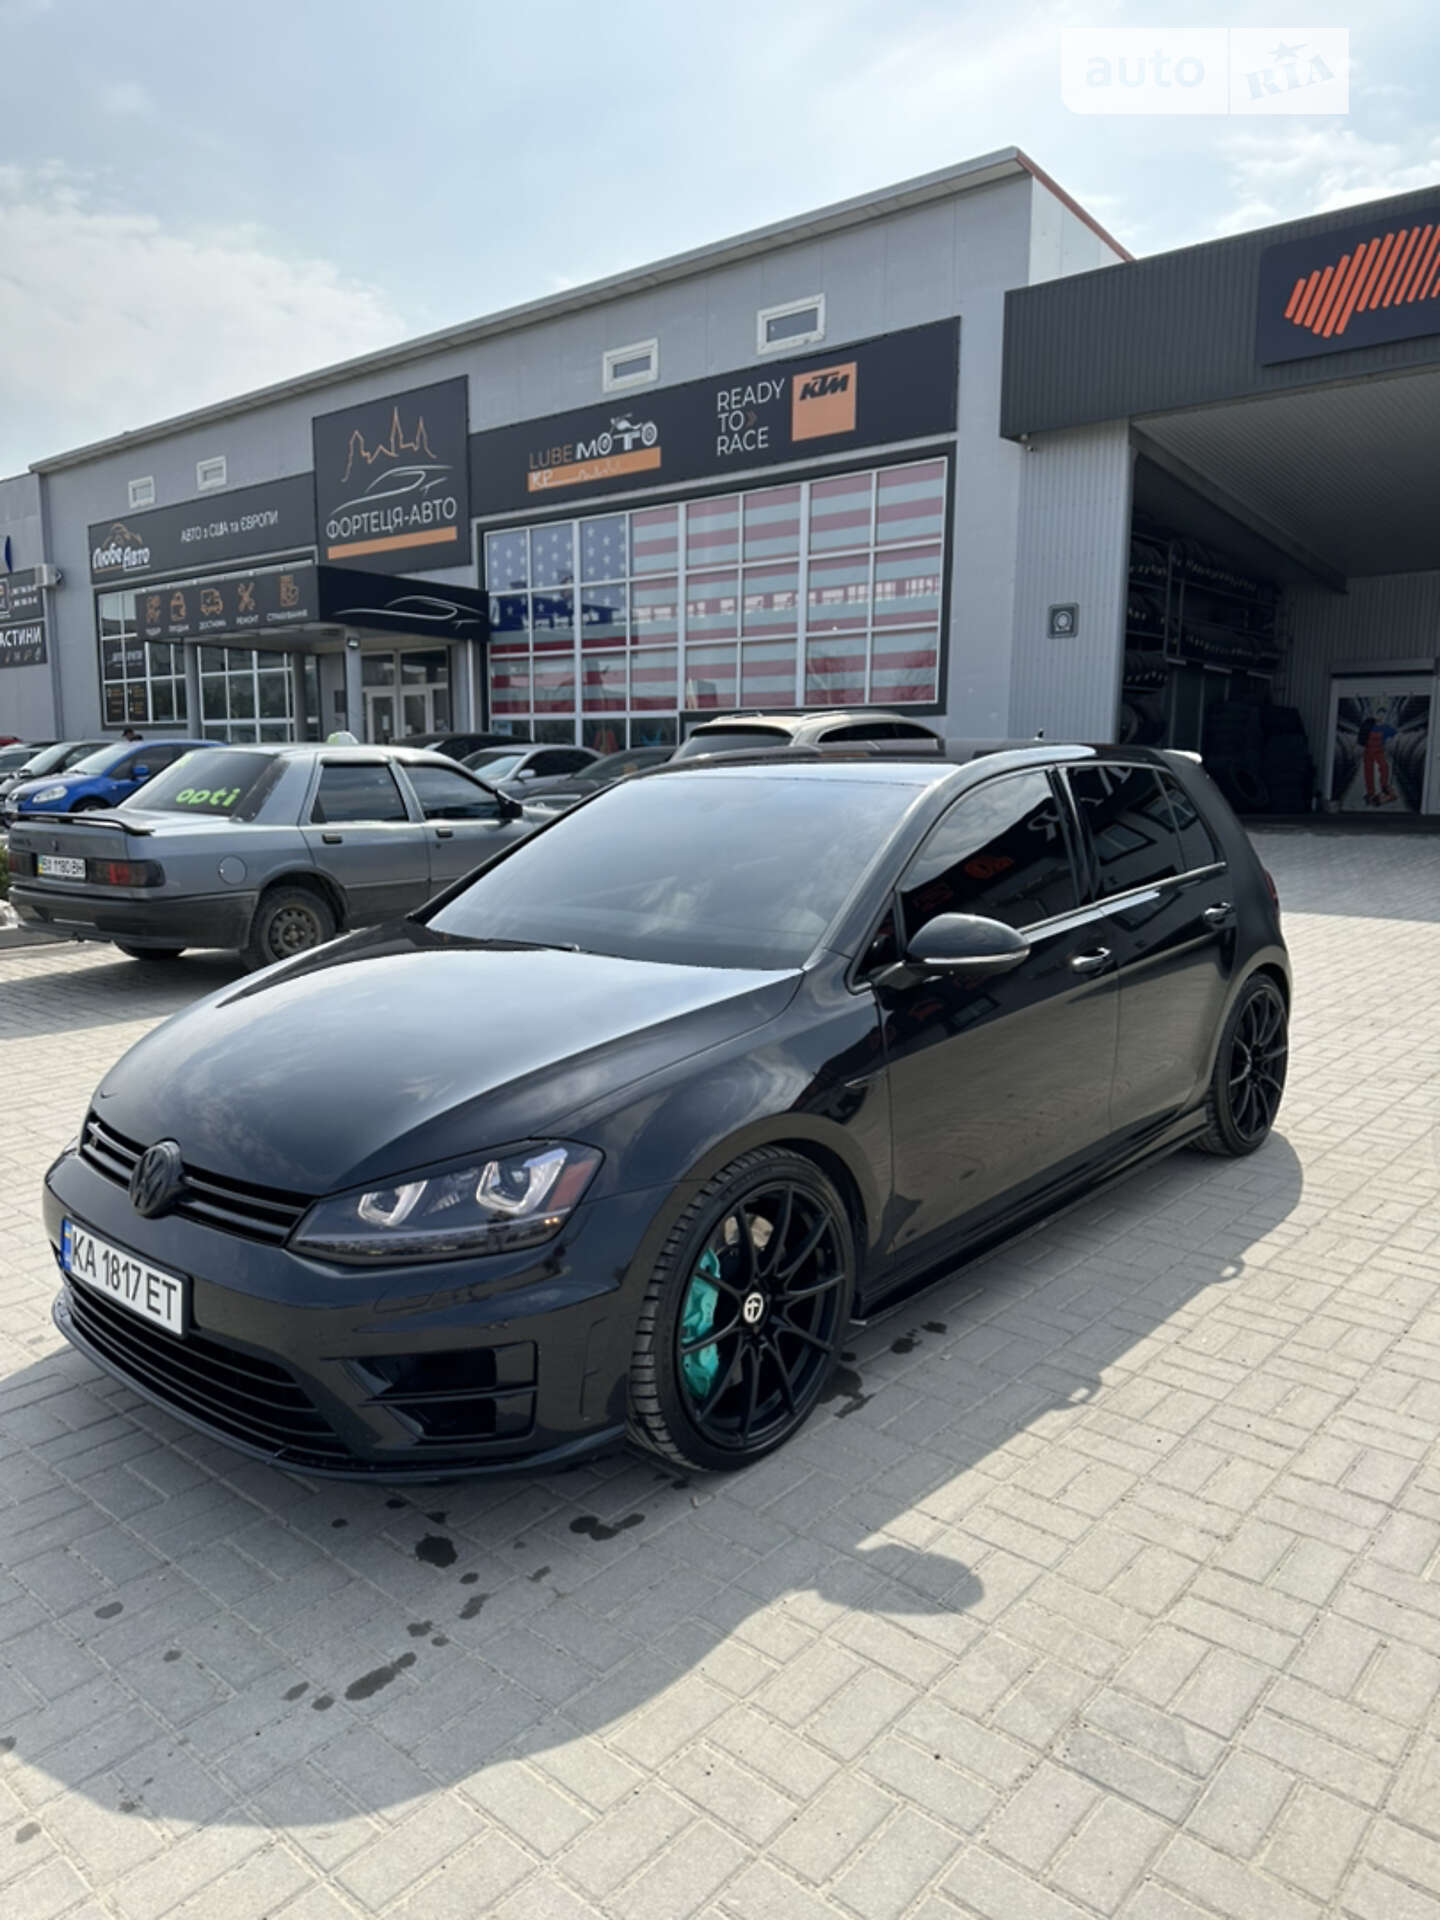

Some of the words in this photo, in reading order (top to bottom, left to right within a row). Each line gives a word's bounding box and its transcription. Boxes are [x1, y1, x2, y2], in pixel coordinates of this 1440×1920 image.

[717, 378, 785, 412] READY
[800, 372, 850, 400] KTM
[718, 410, 745, 433] TO
[717, 426, 769, 456] RACE
[326, 497, 457, 539] ФОРТЕЦЯ-АВТО
[72, 1231, 97, 1278] KA
[102, 1249, 142, 1302] 1817
[146, 1271, 177, 1321] ET
